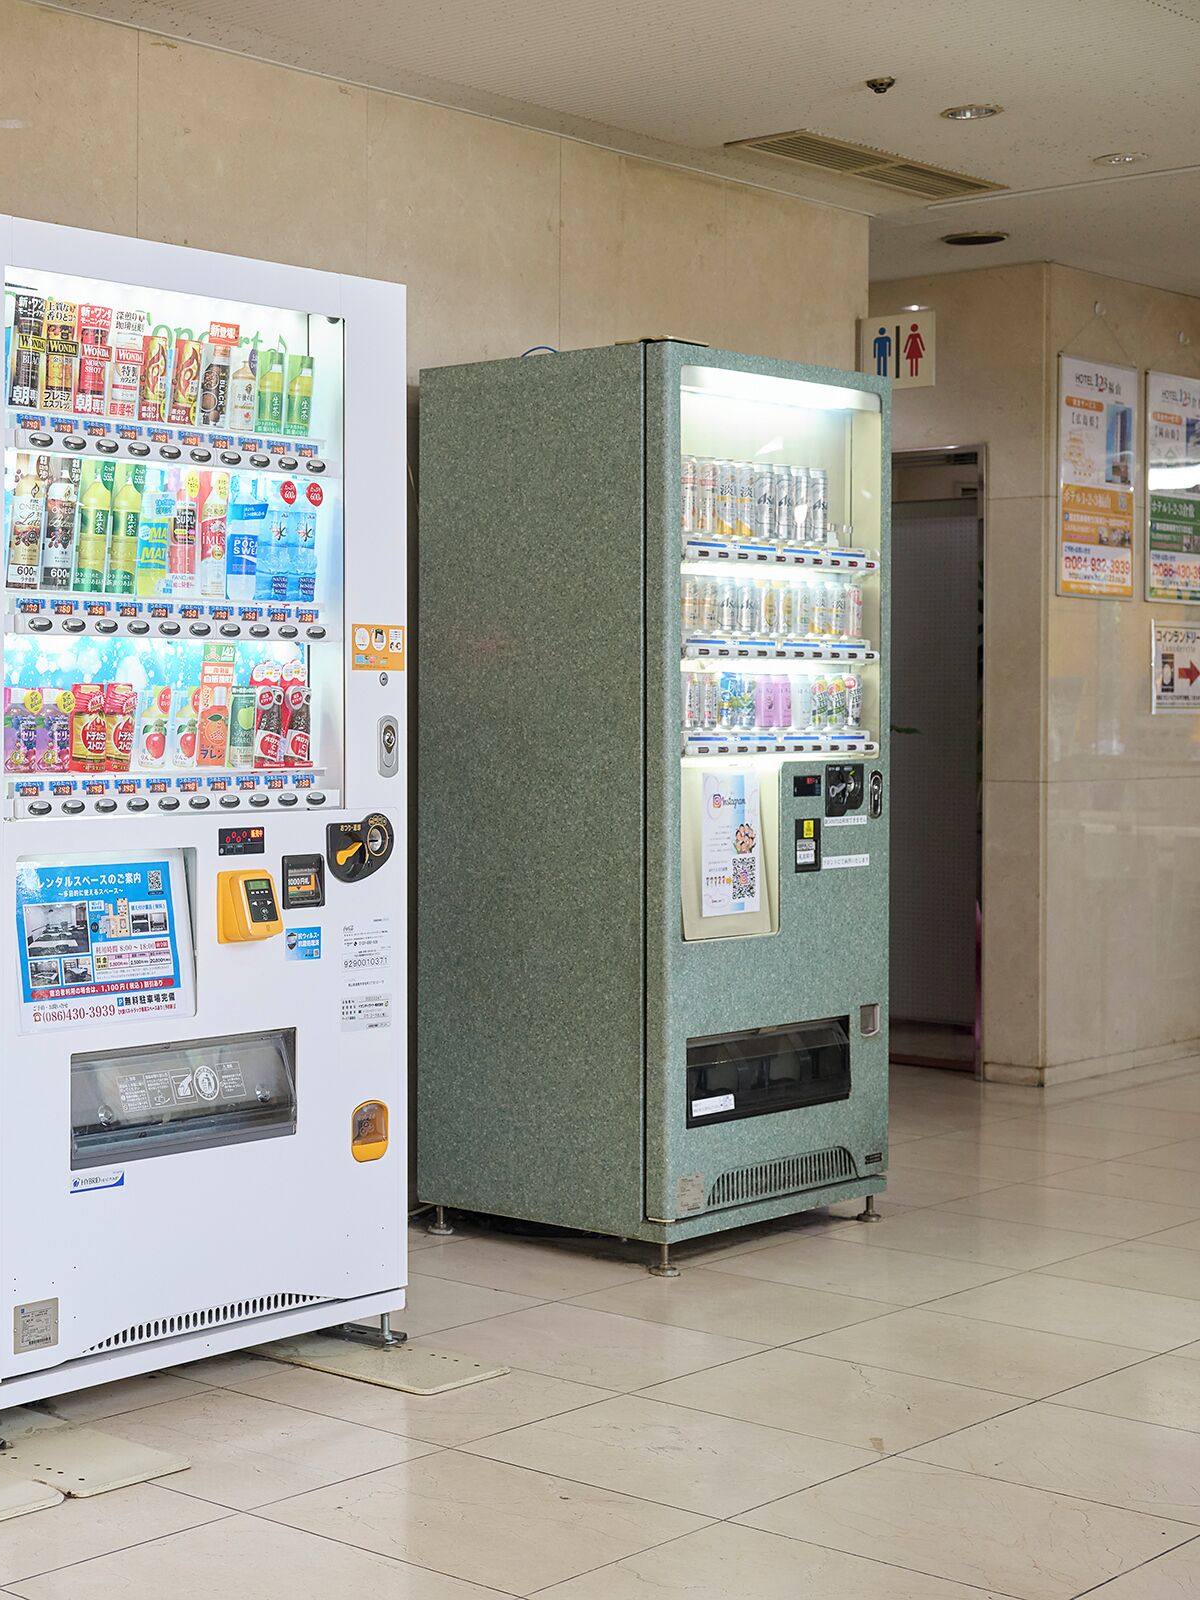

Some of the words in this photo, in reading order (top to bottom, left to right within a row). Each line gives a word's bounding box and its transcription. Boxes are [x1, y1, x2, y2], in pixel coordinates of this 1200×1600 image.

[20, 335, 46, 349] WONDA
[48, 340, 78, 354] WONDA
[82, 344, 110, 358] WONDA
[118, 349, 144, 362] WONDA
[216, 379, 227, 407] BLACK
[142, 547, 167, 561] MAT
[36, 872, 142, 889] レンタルスペースのご案内
[42, 1004, 116, 1024] (086)430-3939
